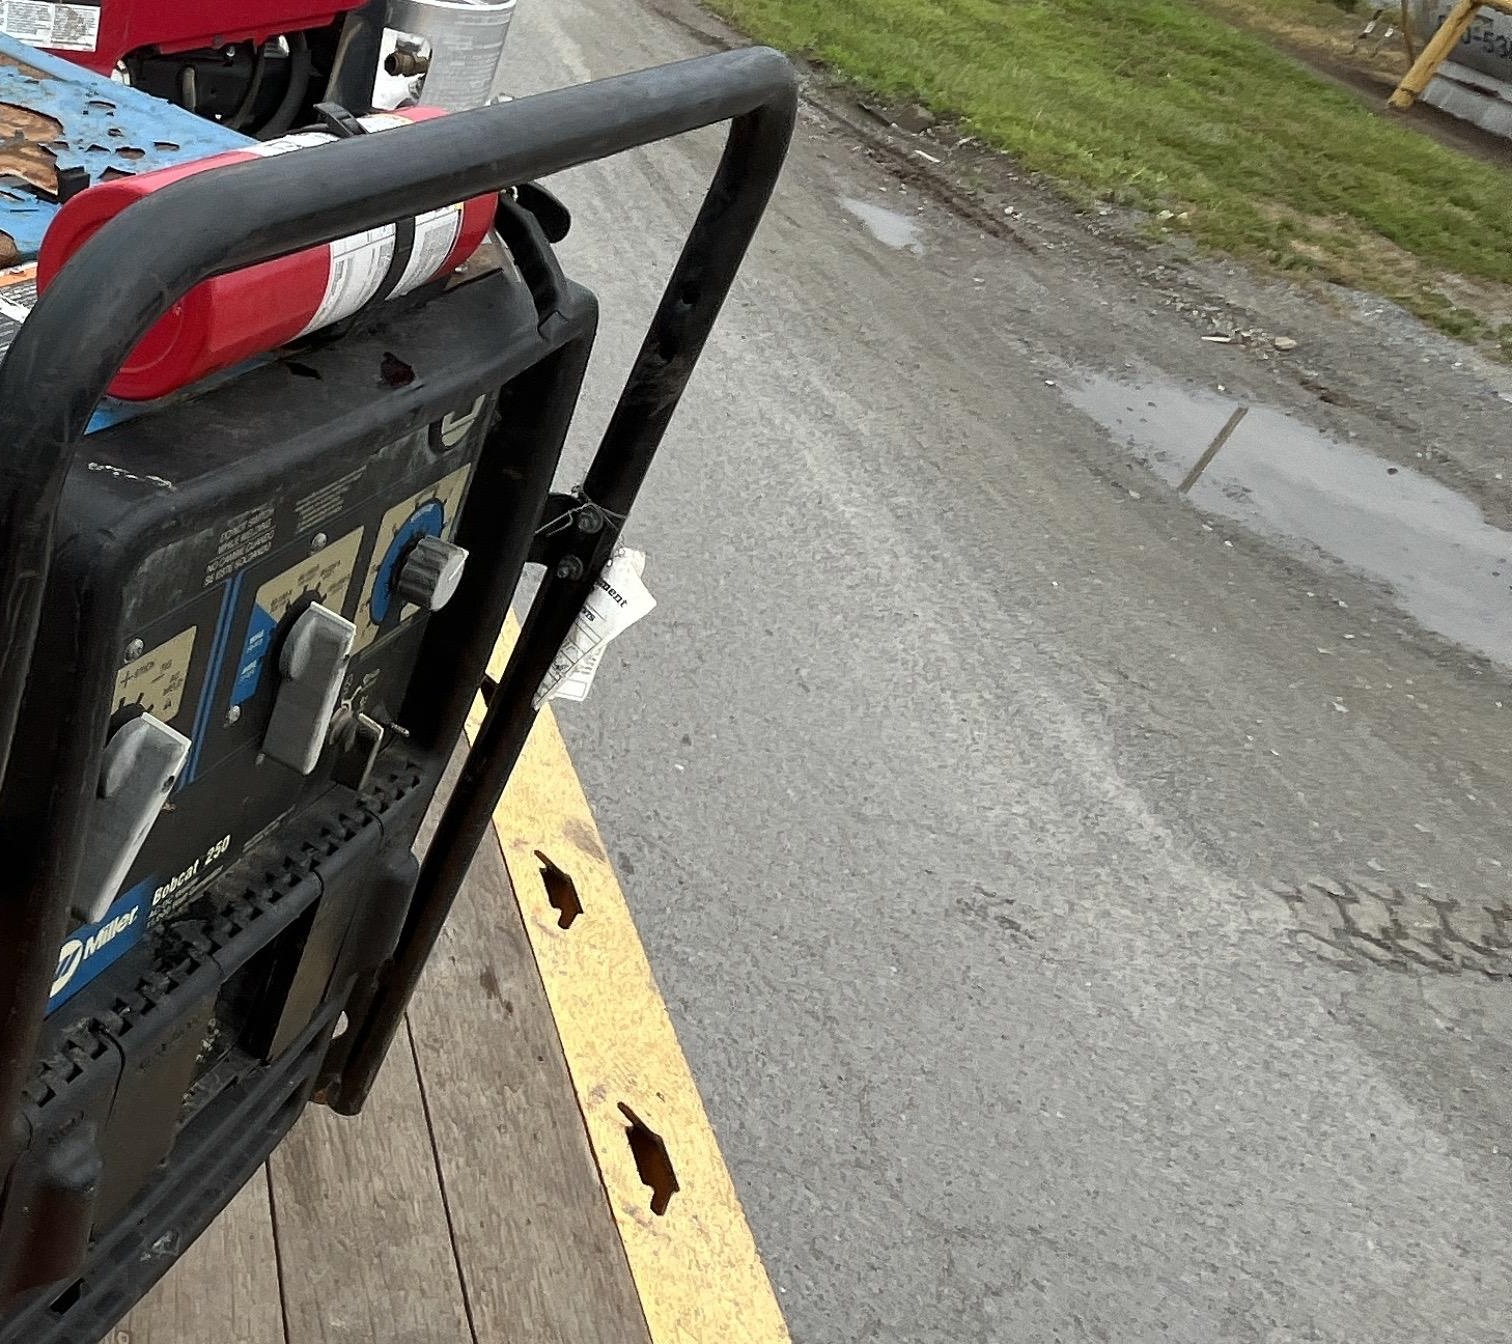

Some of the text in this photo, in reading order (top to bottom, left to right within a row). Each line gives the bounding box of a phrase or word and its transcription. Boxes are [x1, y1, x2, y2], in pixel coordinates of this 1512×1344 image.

[152, 833, 232, 905] Bobcat 250
[83, 905, 139, 960] Miller
